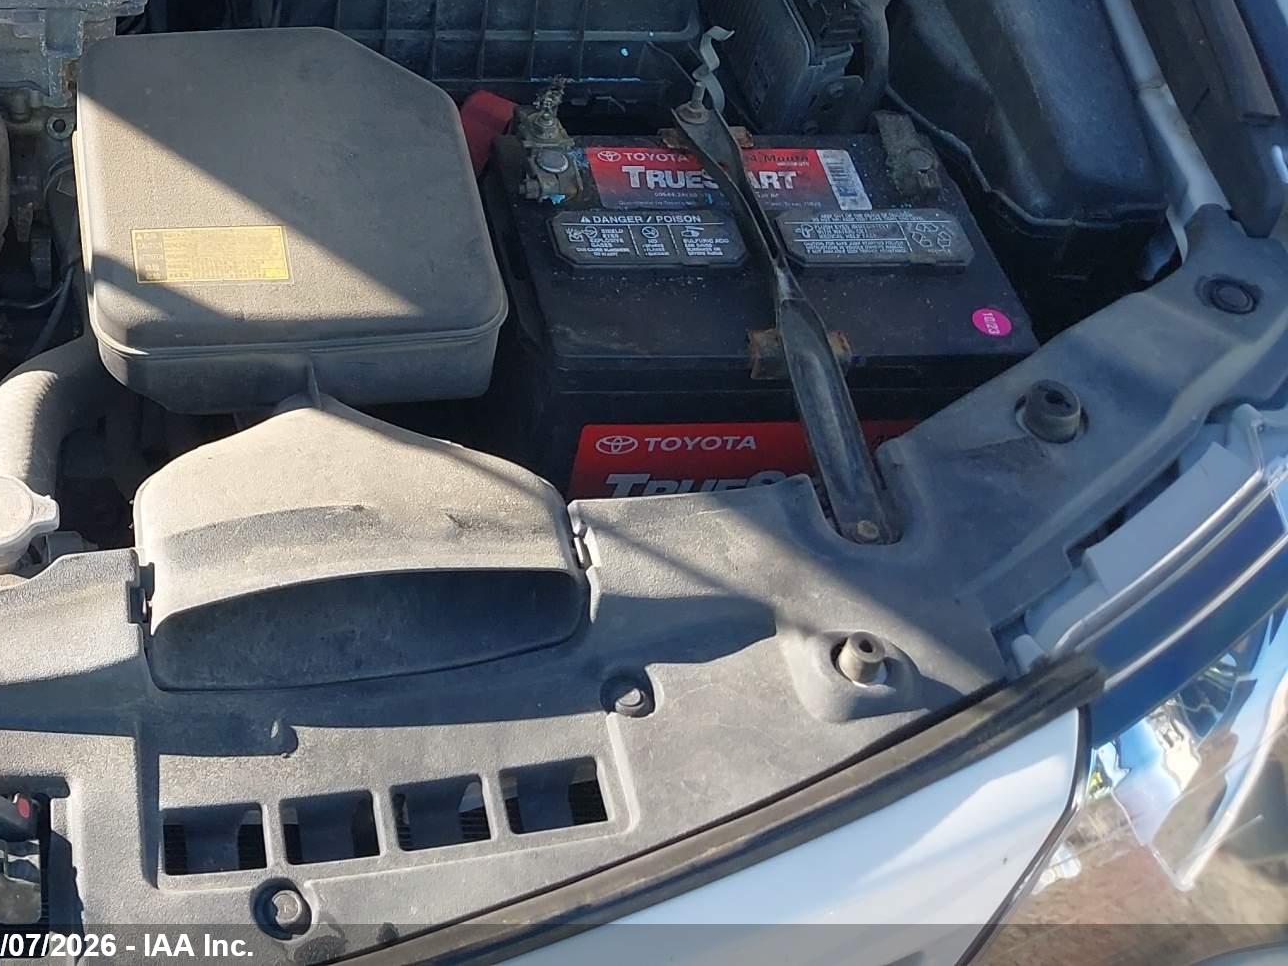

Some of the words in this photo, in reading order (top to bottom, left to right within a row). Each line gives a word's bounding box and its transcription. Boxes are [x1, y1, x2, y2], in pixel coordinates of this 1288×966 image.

[623, 152, 690, 163] TOYOTA
[592, 215, 643, 224] DANGER
[646, 215, 653, 224] /
[656, 215, 702, 224] POISON
[644, 435, 757, 452] TOYOTA
